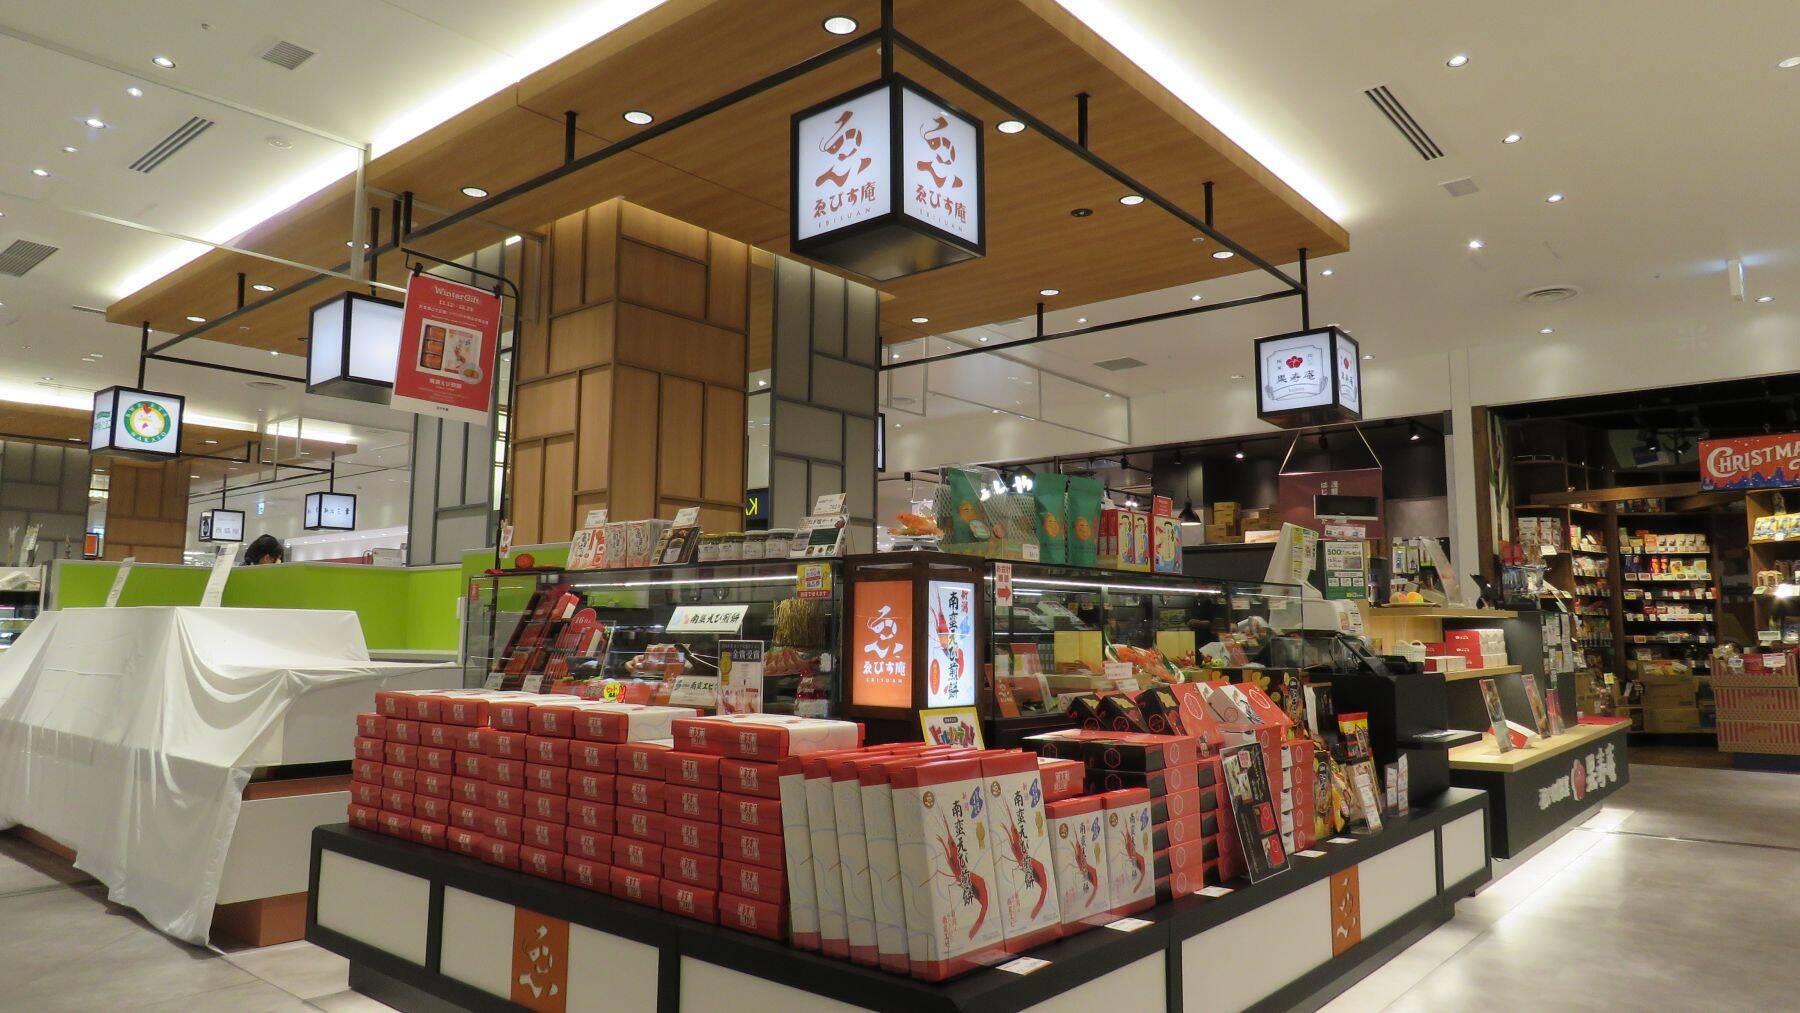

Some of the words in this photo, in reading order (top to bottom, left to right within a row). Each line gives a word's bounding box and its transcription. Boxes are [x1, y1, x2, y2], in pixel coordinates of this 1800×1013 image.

[813, 181, 876, 218] ゑびす庵
[915, 184, 967, 224] ゑびす庵
[947, 591, 959, 700] 南蛮えび煎餅
[863, 661, 906, 677] ゑびす庵
